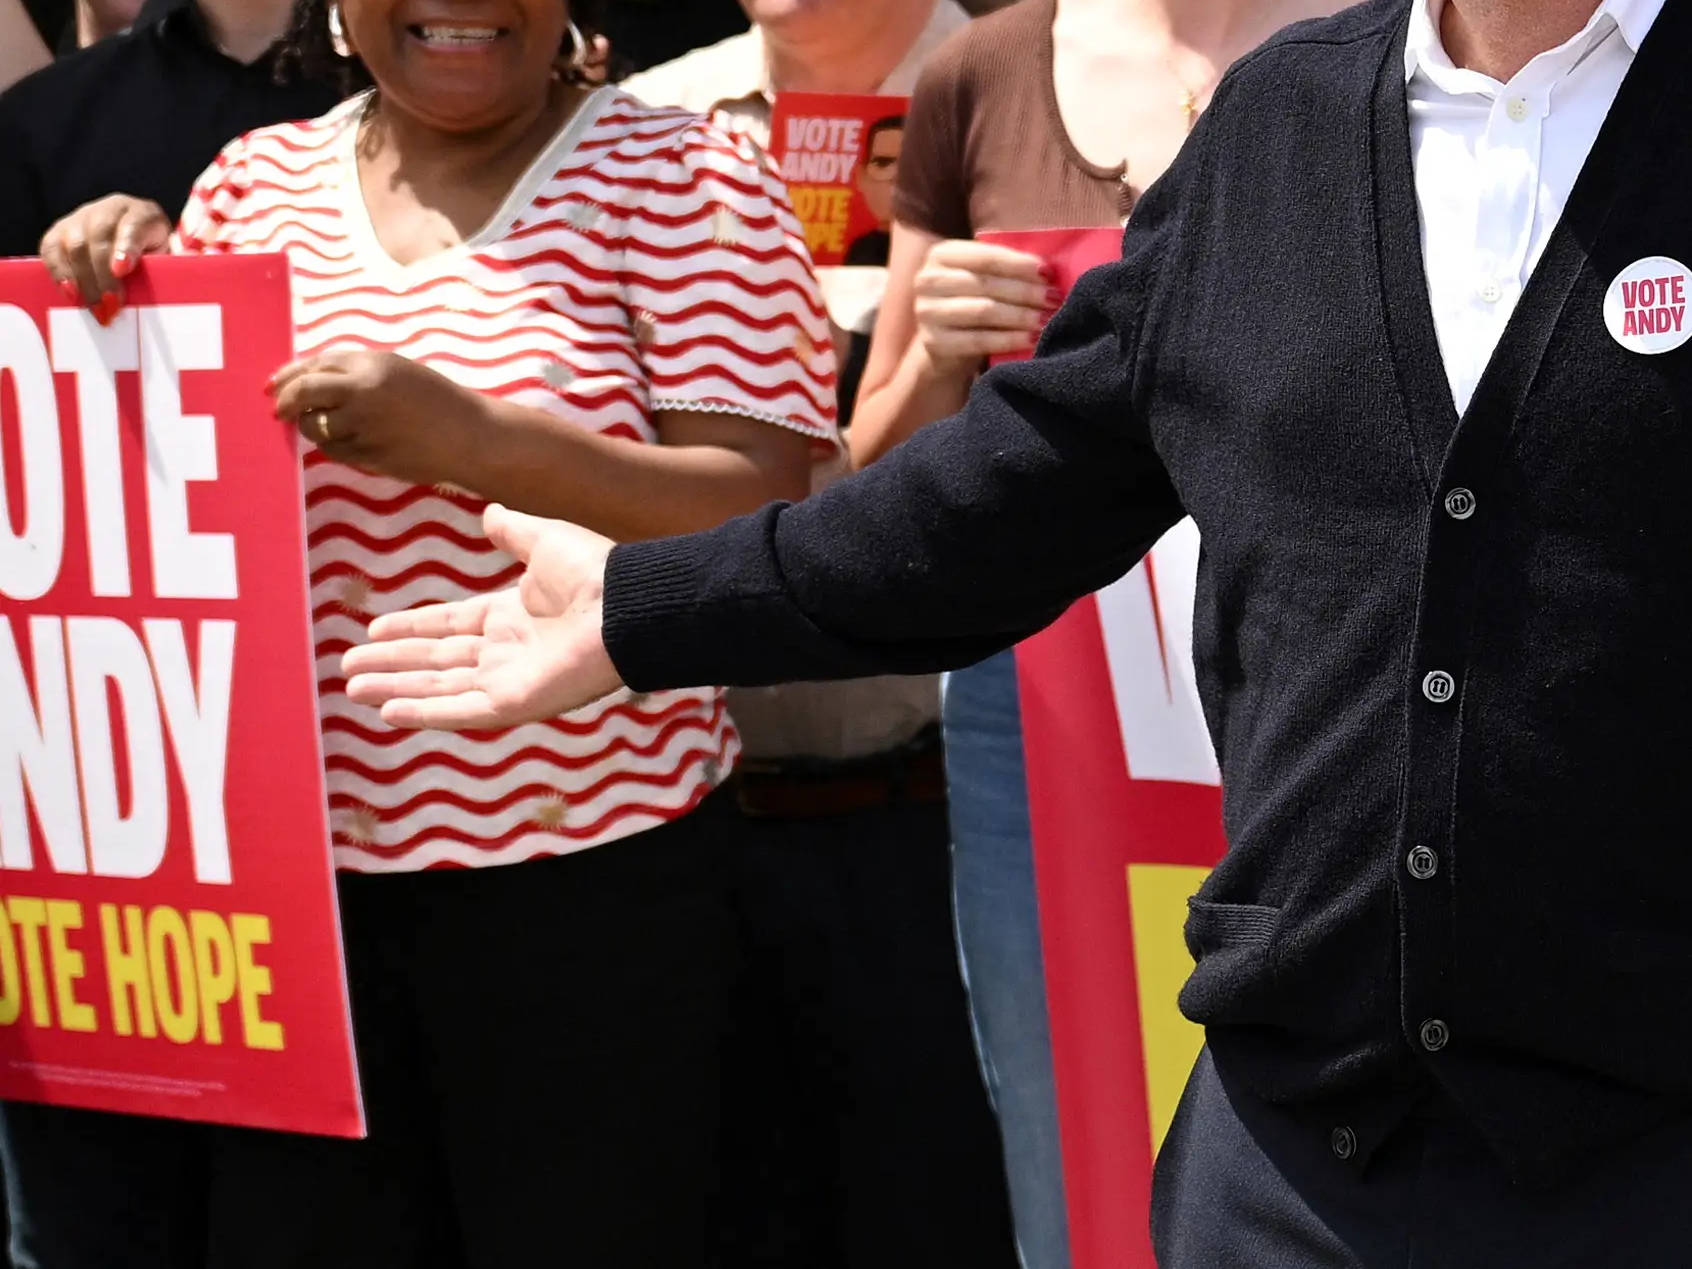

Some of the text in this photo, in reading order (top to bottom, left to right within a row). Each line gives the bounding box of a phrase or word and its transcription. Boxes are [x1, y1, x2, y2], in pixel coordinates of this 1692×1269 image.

[787, 117, 864, 152] VOTE
[780, 151, 858, 184] ANDY
[1621, 275, 1686, 309] VOTE
[1623, 305, 1686, 337] ANDY
[98, 902, 285, 1051] HOPE
